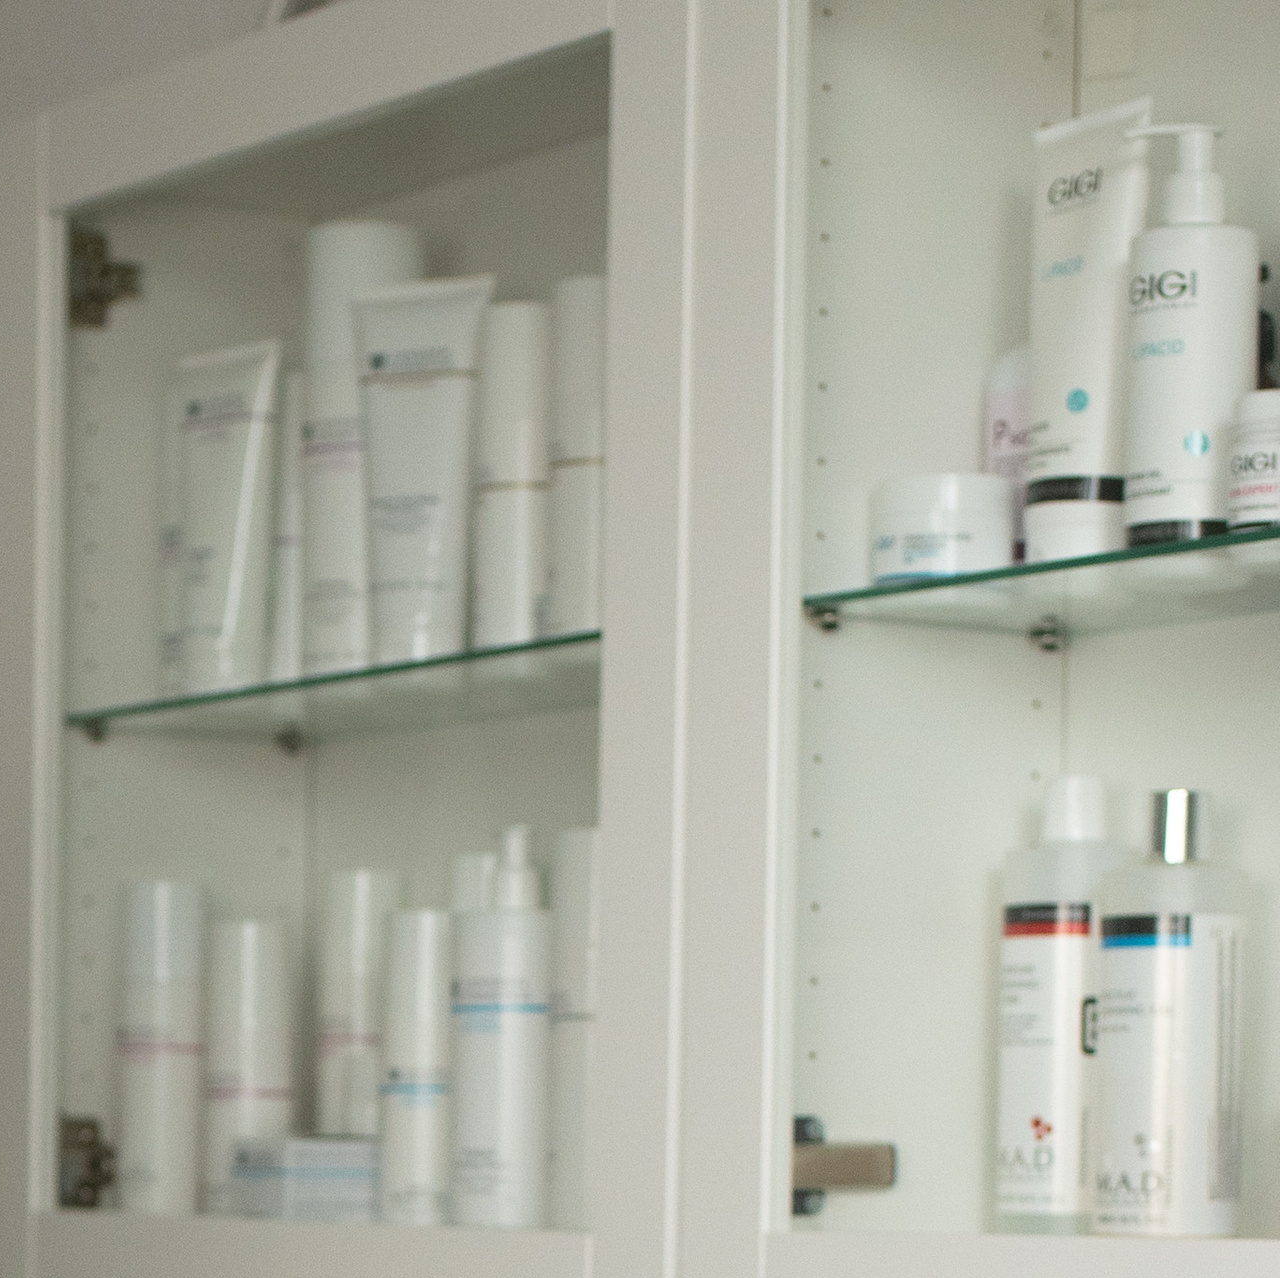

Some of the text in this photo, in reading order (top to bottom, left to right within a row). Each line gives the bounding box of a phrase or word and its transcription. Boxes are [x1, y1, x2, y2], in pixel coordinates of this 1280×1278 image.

[1046, 167, 1105, 206] GIGI
[1128, 269, 1198, 306] GIGI
[1231, 451, 1277, 475] GIGI
